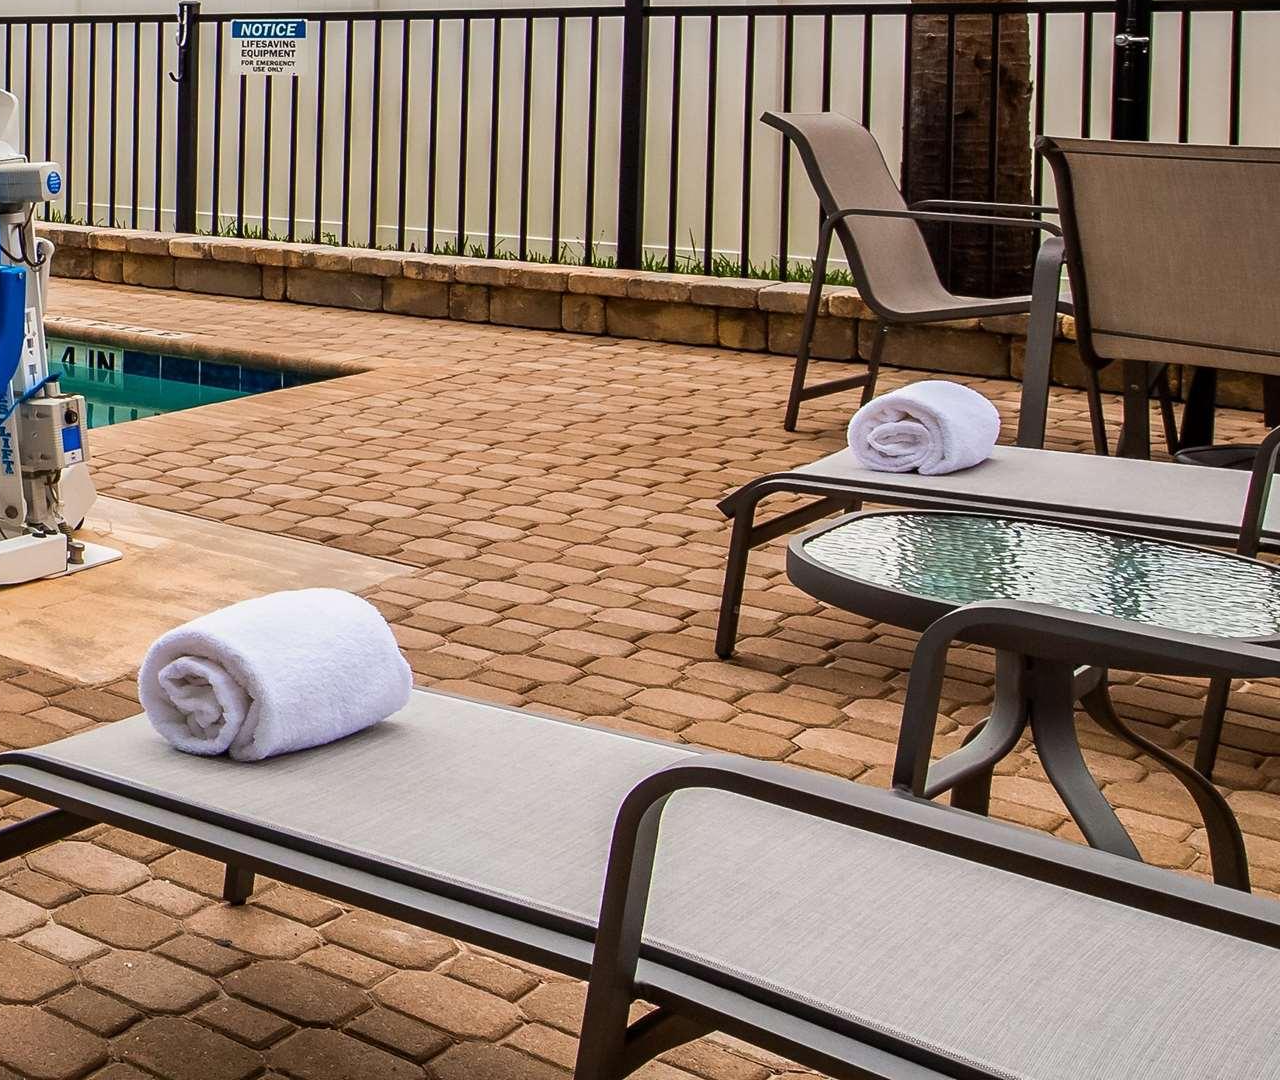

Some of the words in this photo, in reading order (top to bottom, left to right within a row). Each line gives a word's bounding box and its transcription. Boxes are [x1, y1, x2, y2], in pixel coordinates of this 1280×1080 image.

[241, 23, 297, 36] NOTICE
[241, 40, 296, 48] LIFESAVING
[241, 49, 296, 58] EQUIPMENT
[61, 345, 76, 366] 4
[88, 349, 116, 371] IN
[0, 426, 15, 475] LIFT
